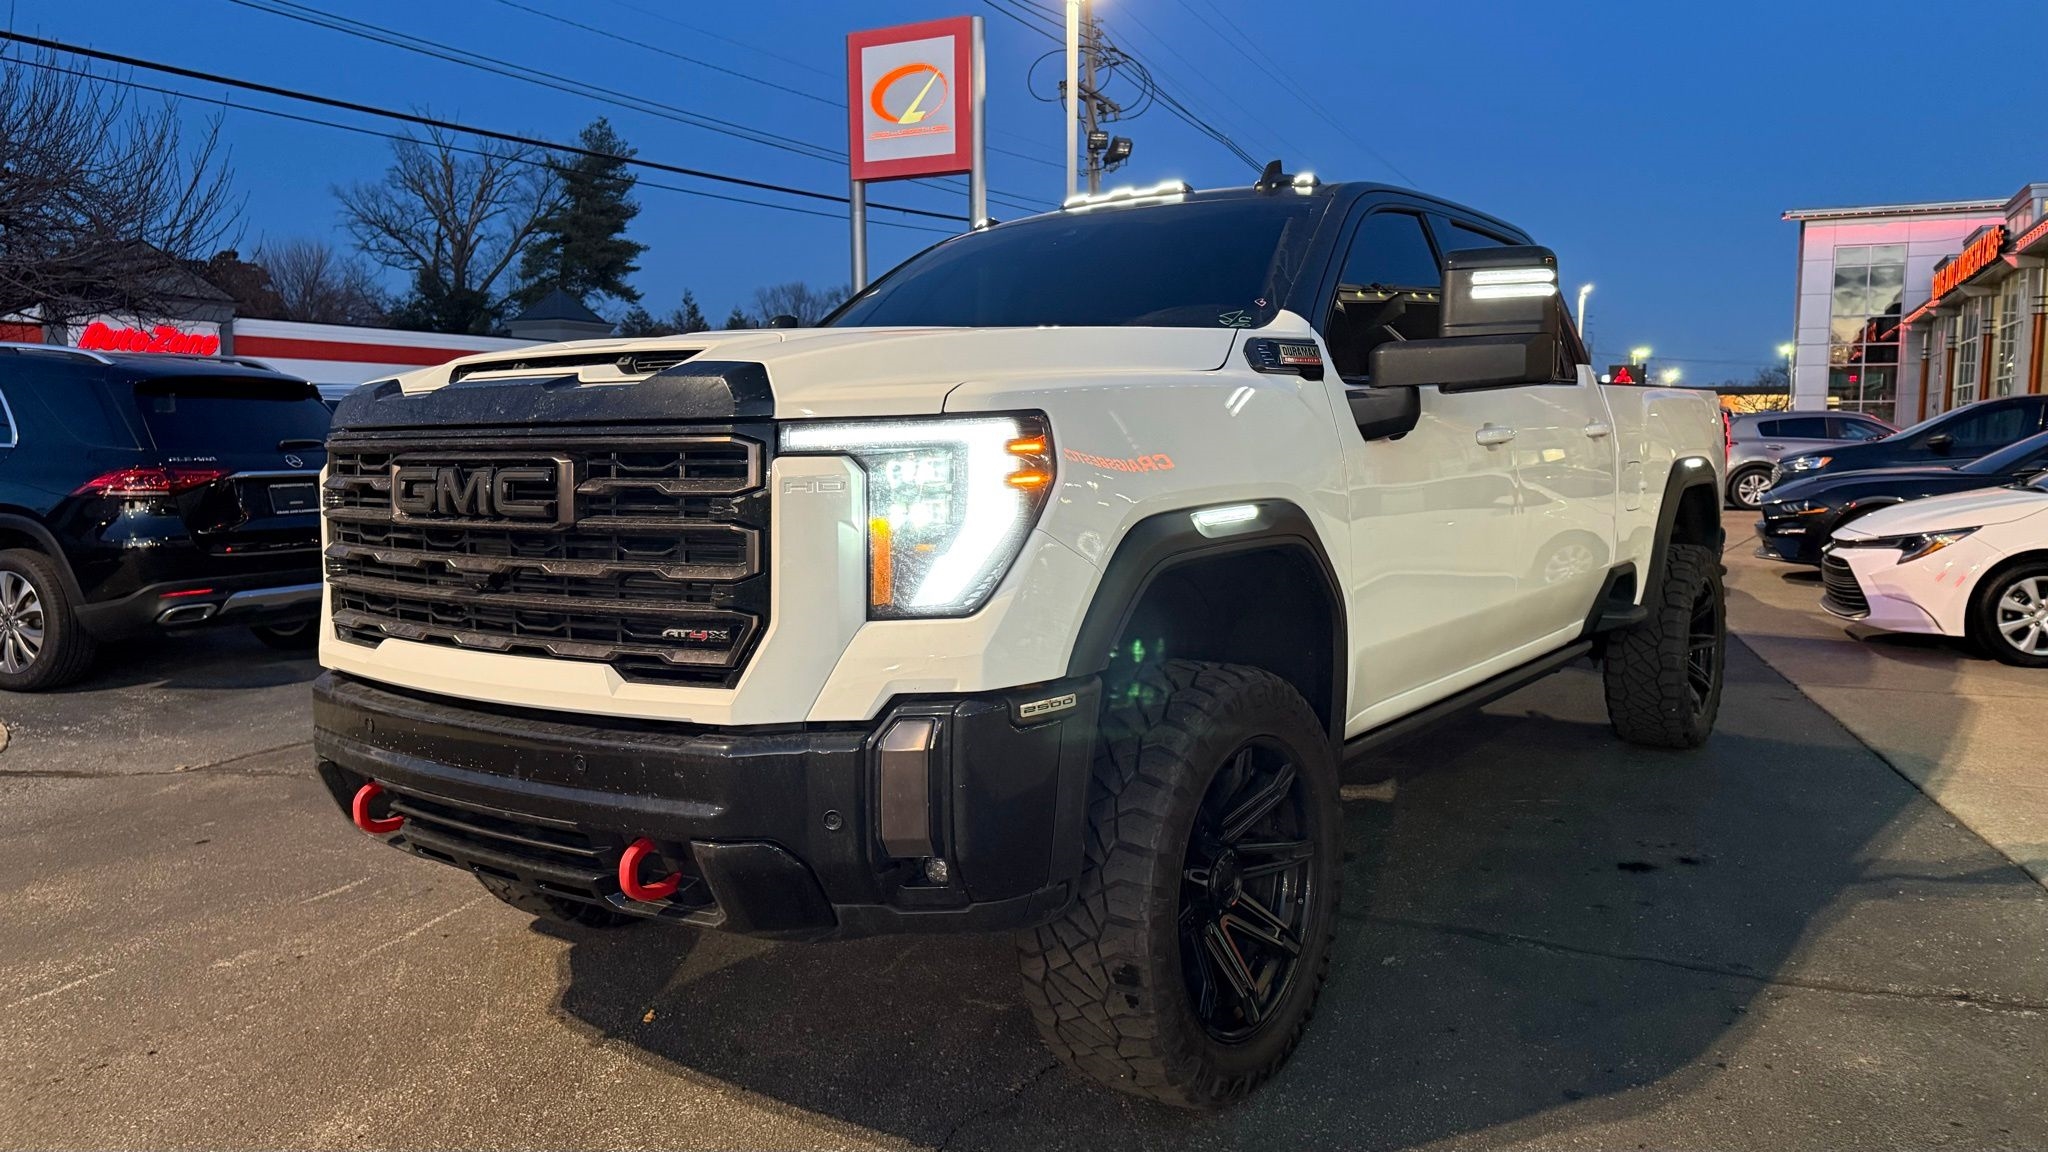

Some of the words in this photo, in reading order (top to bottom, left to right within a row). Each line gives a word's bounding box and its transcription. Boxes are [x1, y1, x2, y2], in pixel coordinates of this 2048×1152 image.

[78, 322, 220, 357] AutoZone
[394, 466, 555, 518] GMC
[784, 481, 846, 494] HD
[662, 628, 728, 642] AT4X
[1023, 697, 1073, 714] 2500
